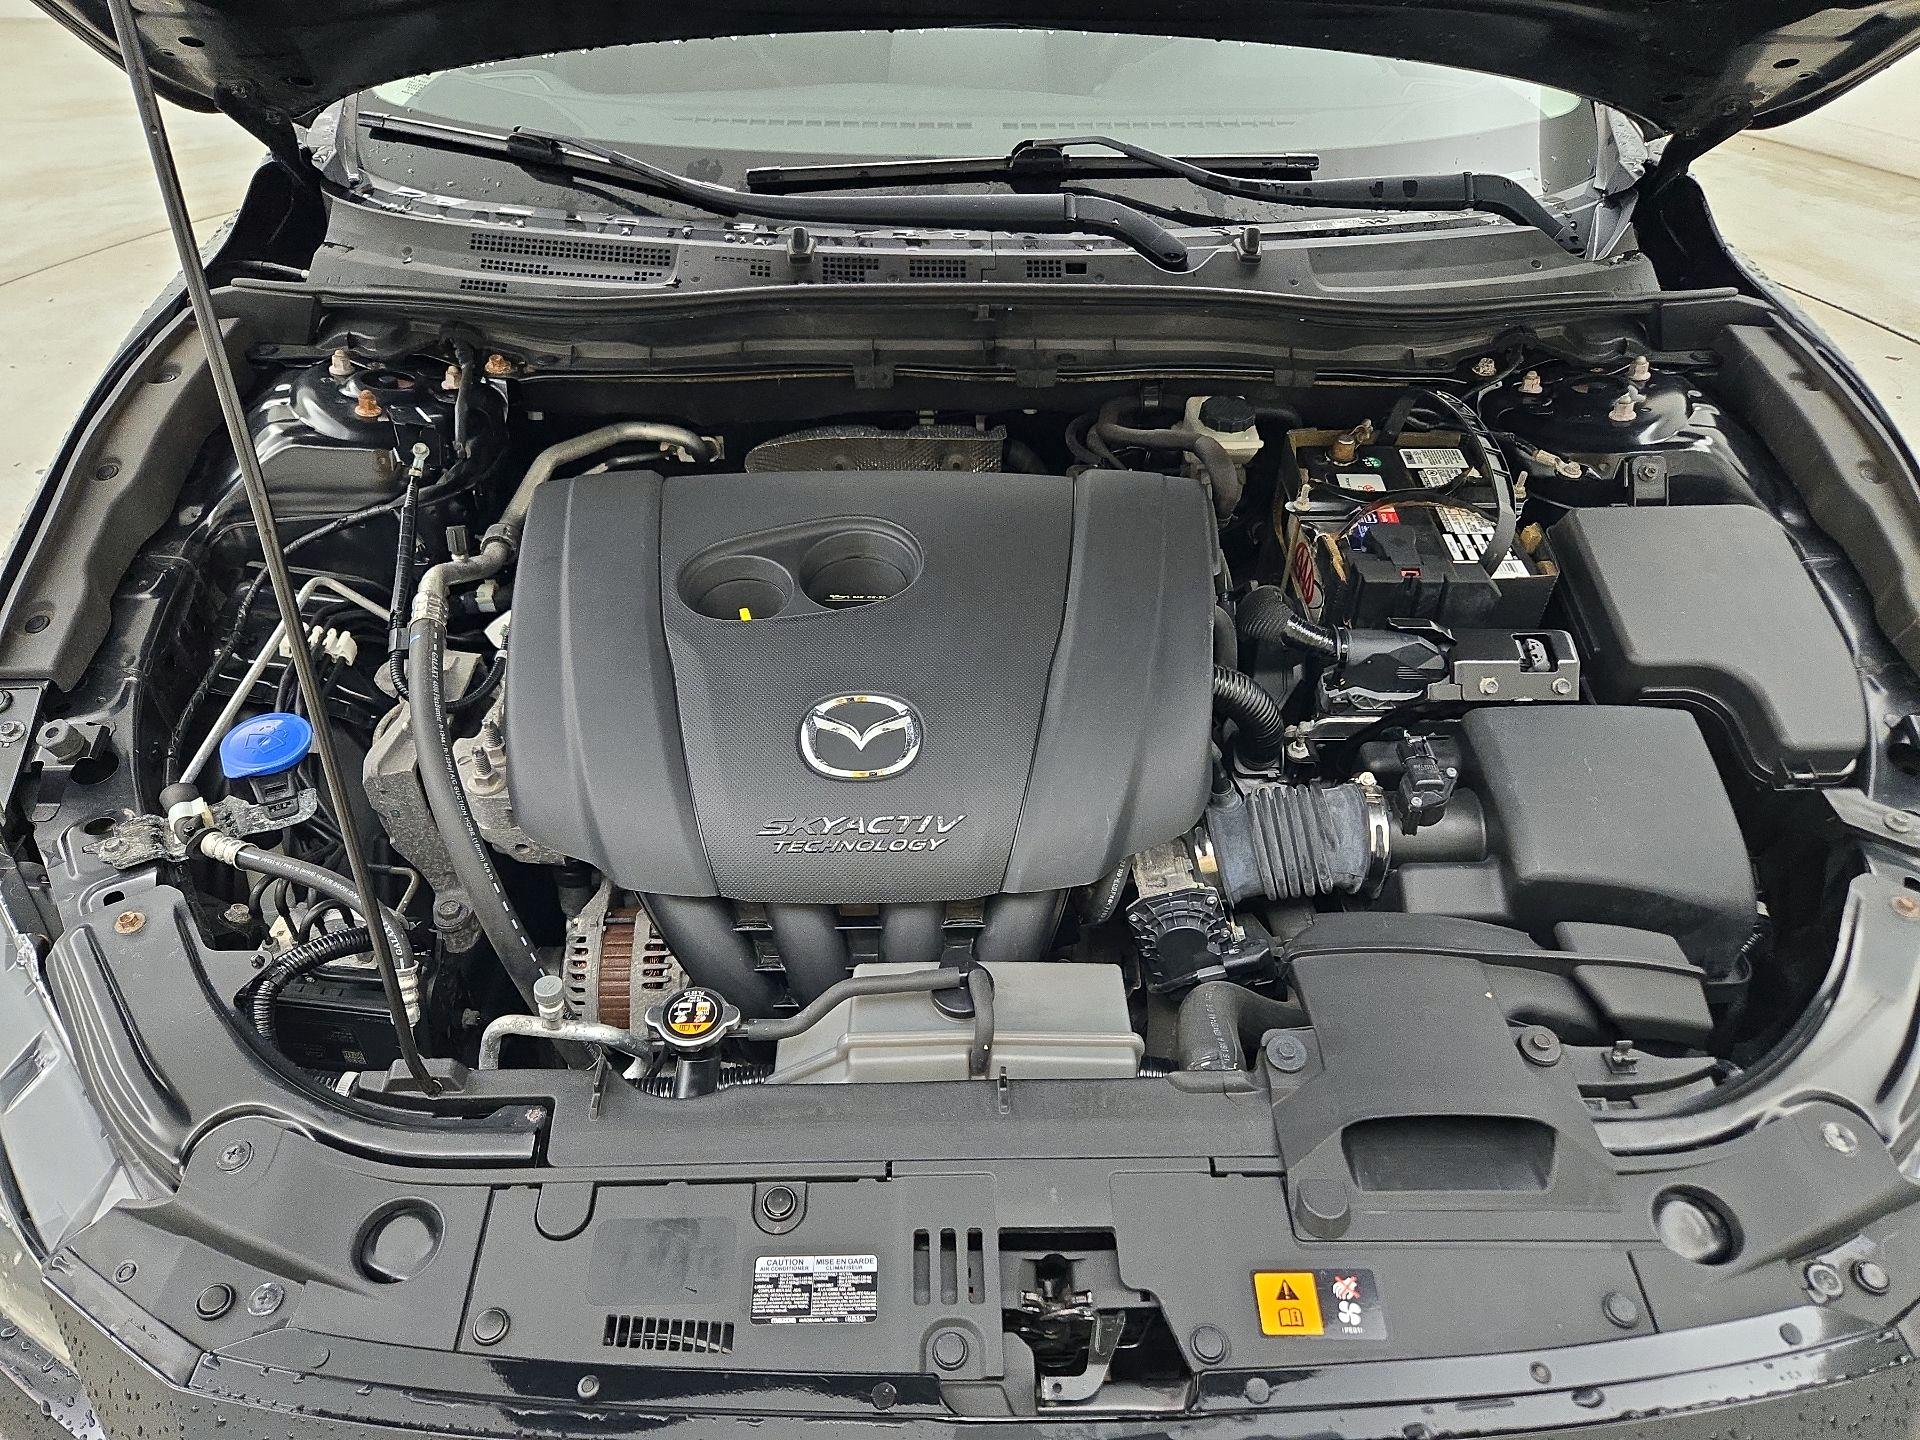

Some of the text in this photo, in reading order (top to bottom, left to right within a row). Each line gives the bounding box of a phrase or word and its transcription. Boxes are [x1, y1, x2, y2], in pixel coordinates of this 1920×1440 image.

[431, 651, 439, 680] GALAXY
[450, 773, 458, 785] A/C
[453, 786, 469, 816] SUCTION
[464, 816, 476, 837] HOSE
[756, 815, 967, 836] SKYACTIV
[773, 838, 949, 853] TECHNOLOGY
[766, 1258, 804, 1267] CAUTION
[816, 1258, 835, 1266] MISE
[847, 1257, 875, 1265] GARDE
